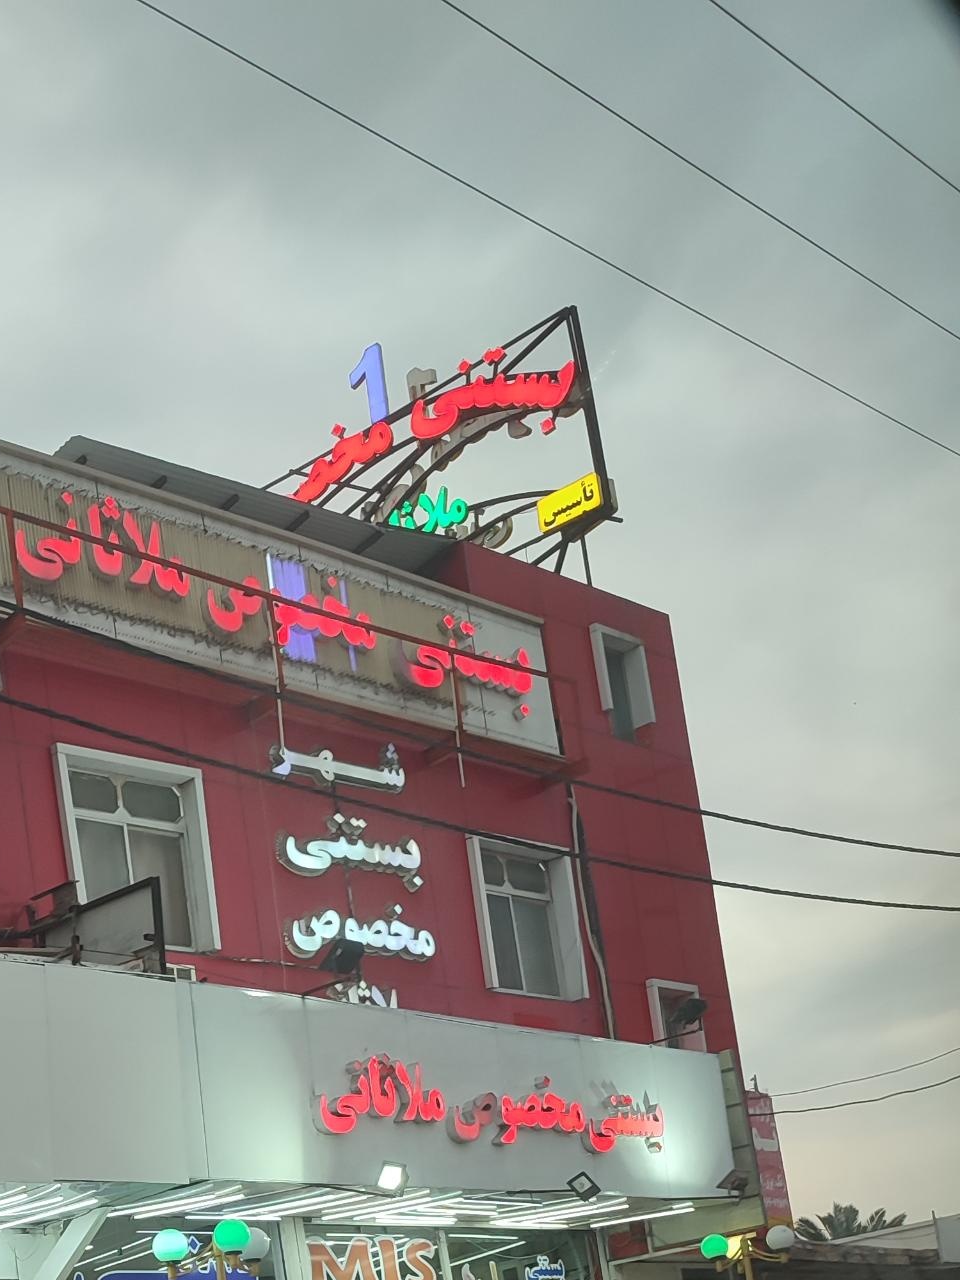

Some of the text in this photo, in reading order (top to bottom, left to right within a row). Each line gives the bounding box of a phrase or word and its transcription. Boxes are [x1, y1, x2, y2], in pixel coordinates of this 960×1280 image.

[411, 346, 575, 438] بستنی
[543, 479, 594, 527] تأسیس
[14, 491, 189, 598] ملاثانی
[286, 812, 424, 887] بستنی
[292, 904, 436, 957] مخصوص
[314, 1054, 446, 1135] ملاثانی
[449, 1076, 586, 1144] مخصوص
[589, 1094, 665, 1153] بستنی
